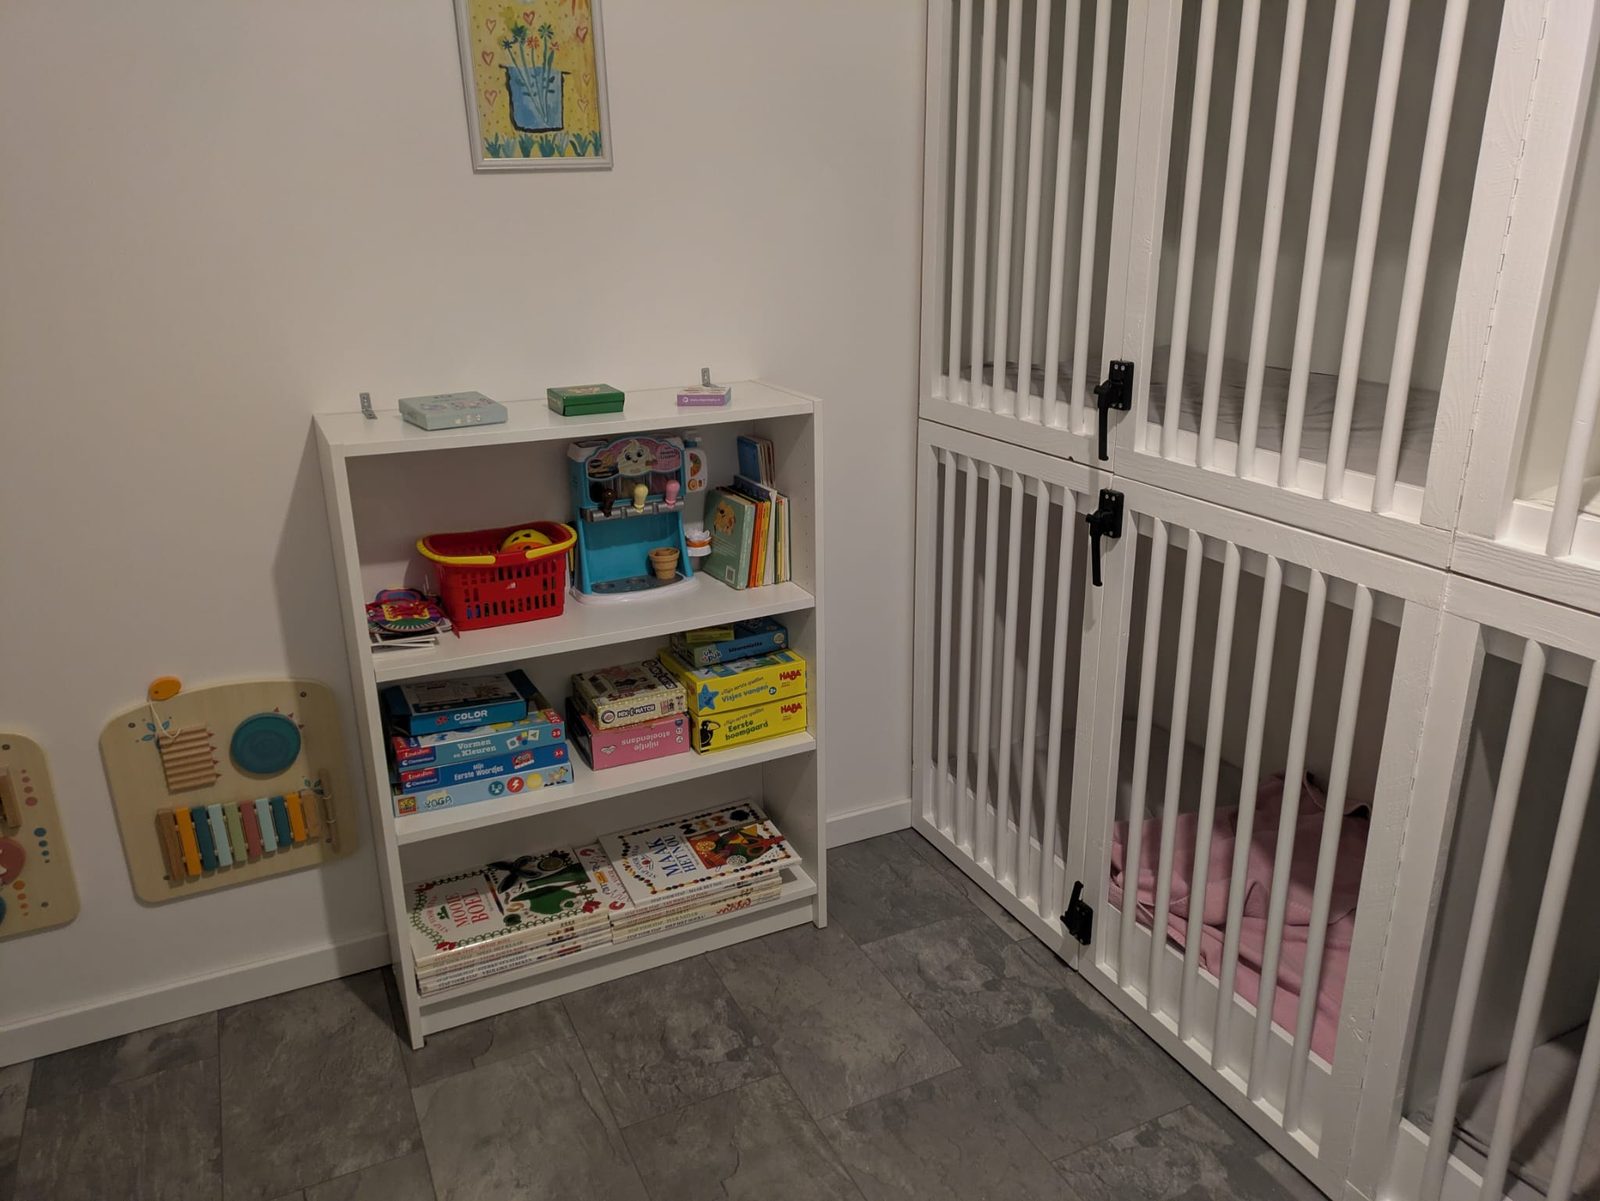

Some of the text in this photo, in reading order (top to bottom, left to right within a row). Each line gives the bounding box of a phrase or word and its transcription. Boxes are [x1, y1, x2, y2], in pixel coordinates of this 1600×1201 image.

[779, 669, 802, 680] HABA
[743, 684, 769, 696] vangen
[635, 704, 656, 714] MATCH
[780, 703, 802, 714] HABA
[453, 709, 489, 721] COLOR
[725, 721, 769, 740] boomgaard
[728, 720, 754, 732] Eerste
[621, 731, 671, 745] stoelendans
[457, 739, 492, 750] Vormen
[634, 741, 660, 751] nijntje
[461, 745, 497, 757] Kleuren
[454, 765, 504, 781] Eerste Woordjes
[424, 795, 453, 809] YOGA
[648, 837, 683, 877] MAAK
[677, 854, 697, 873] HET
[445, 893, 468, 928] MOOIE
[462, 887, 490, 923] BOEL
